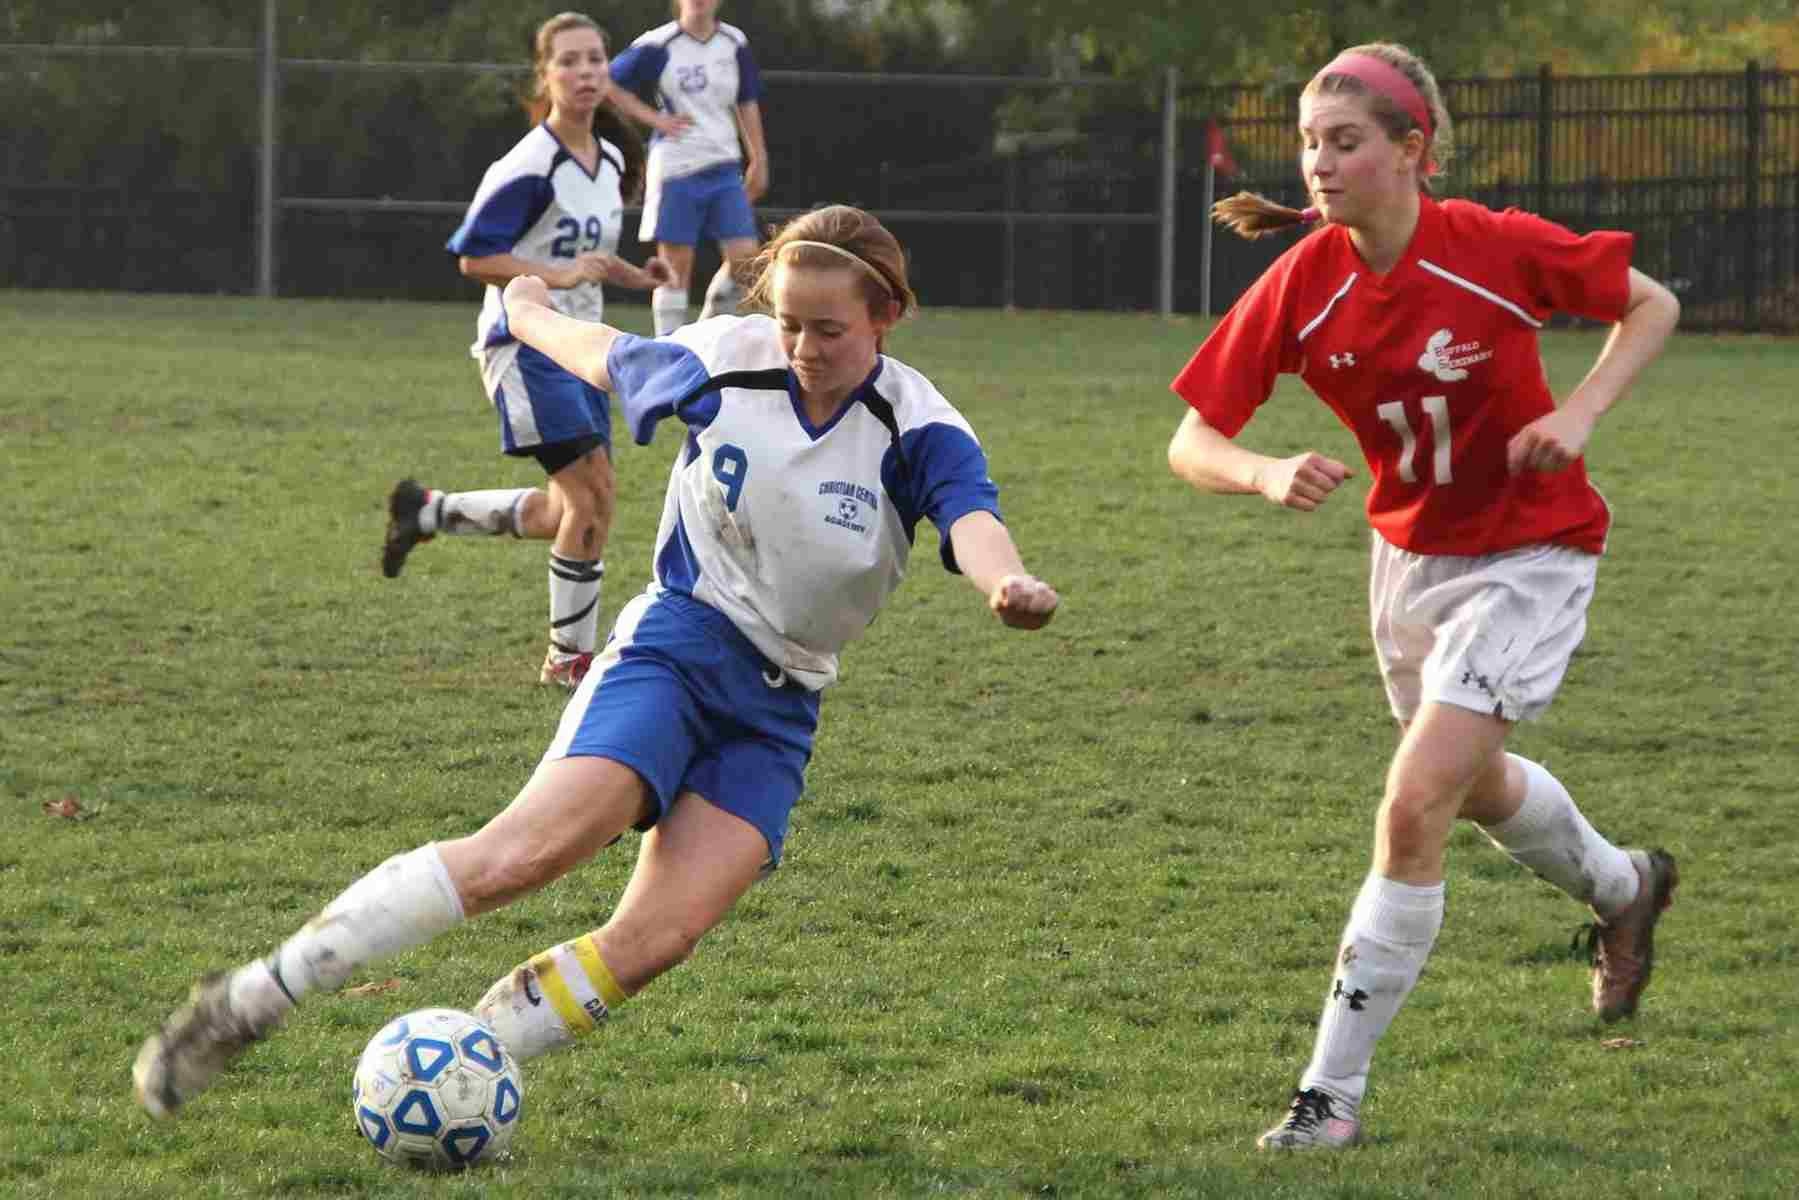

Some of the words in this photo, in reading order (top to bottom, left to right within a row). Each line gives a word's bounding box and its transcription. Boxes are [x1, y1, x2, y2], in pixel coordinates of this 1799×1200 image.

[676, 64, 709, 94] 25
[551, 214, 602, 259] 29
[1376, 395, 1453, 486] 11
[712, 443, 748, 513] 9
